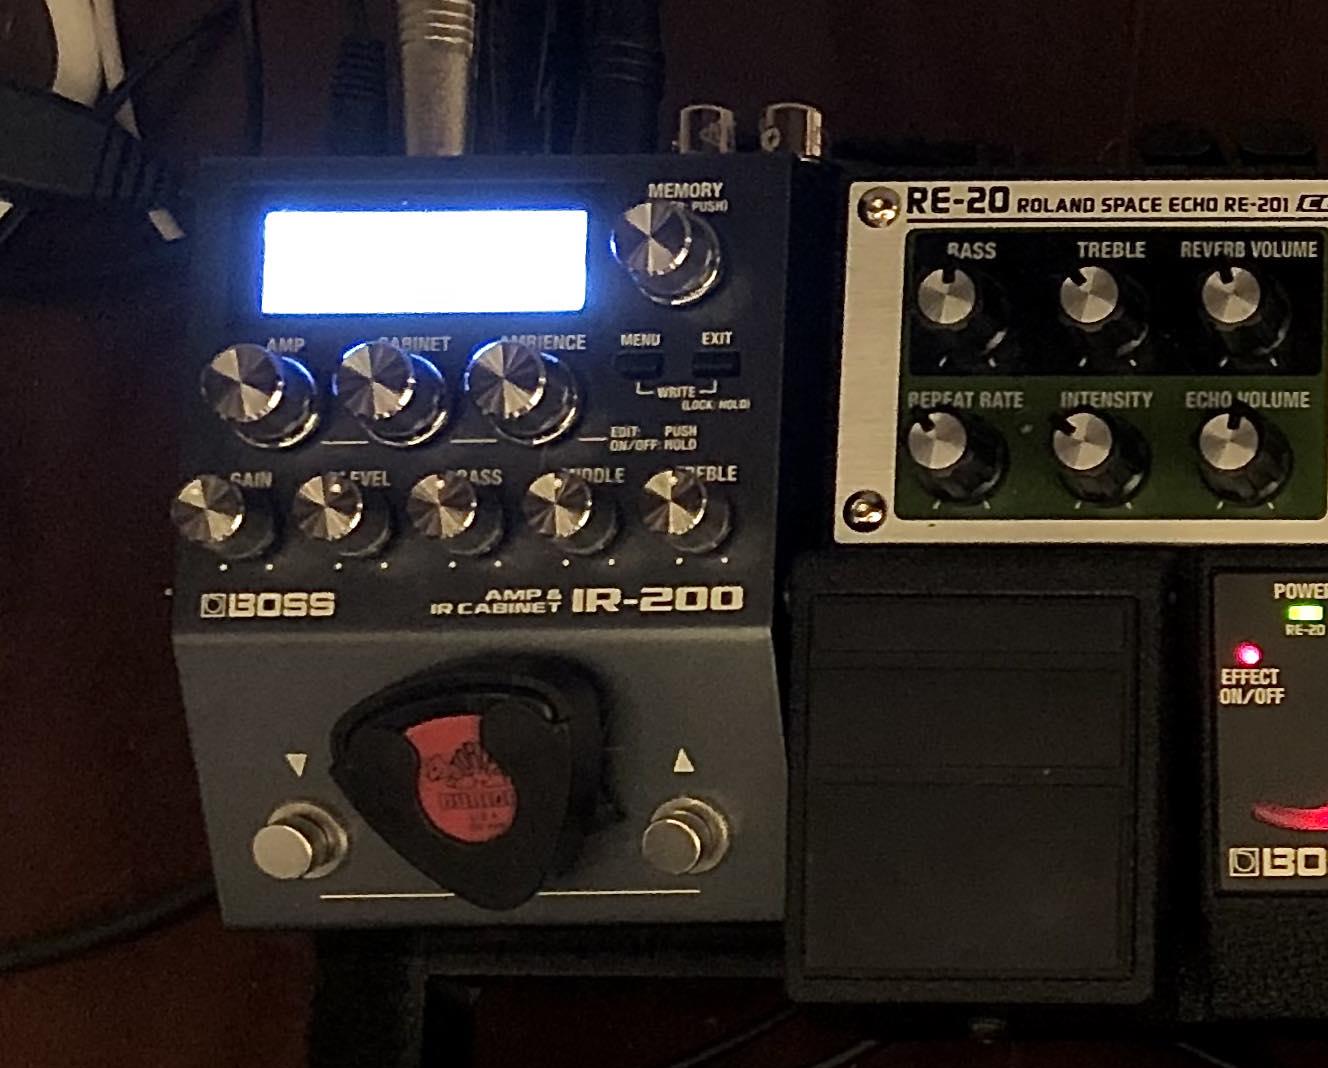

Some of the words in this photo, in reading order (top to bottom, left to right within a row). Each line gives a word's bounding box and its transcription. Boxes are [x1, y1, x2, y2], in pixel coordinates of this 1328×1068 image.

[648, 182, 723, 198] MEMORY
[907, 187, 1010, 214] RE-20
[1017, 197, 1095, 214] ROLAND
[1101, 197, 1164, 213] SPACE
[1168, 197, 1217, 212] ECHO
[1224, 197, 1289, 213] RE-201
[1078, 241, 1147, 258] TREBLE
[1251, 241, 1318, 258] VOLUME
[267, 337, 305, 353] AMP
[621, 334, 660, 346] MENU
[702, 331, 732, 345] EXIT
[658, 387, 695, 398] WRITE
[979, 391, 1024, 409] RATE
[1060, 391, 1153, 409] INTENSITY
[1186, 391, 1232, 409] ECHO
[665, 425, 697, 437] PUSH
[664, 439, 696, 450] HOLD
[485, 590, 543, 601] AMP
[547, 588, 561, 602] &
[571, 586, 744, 612] IR-200
[229, 592, 336, 618] BOSS
[430, 602, 453, 615] IR
[457, 601, 562, 615] CABINET
[1285, 624, 1326, 635] RE-20
[1221, 669, 1279, 685] EFFECT
[1219, 688, 1285, 704] ON/OFF
